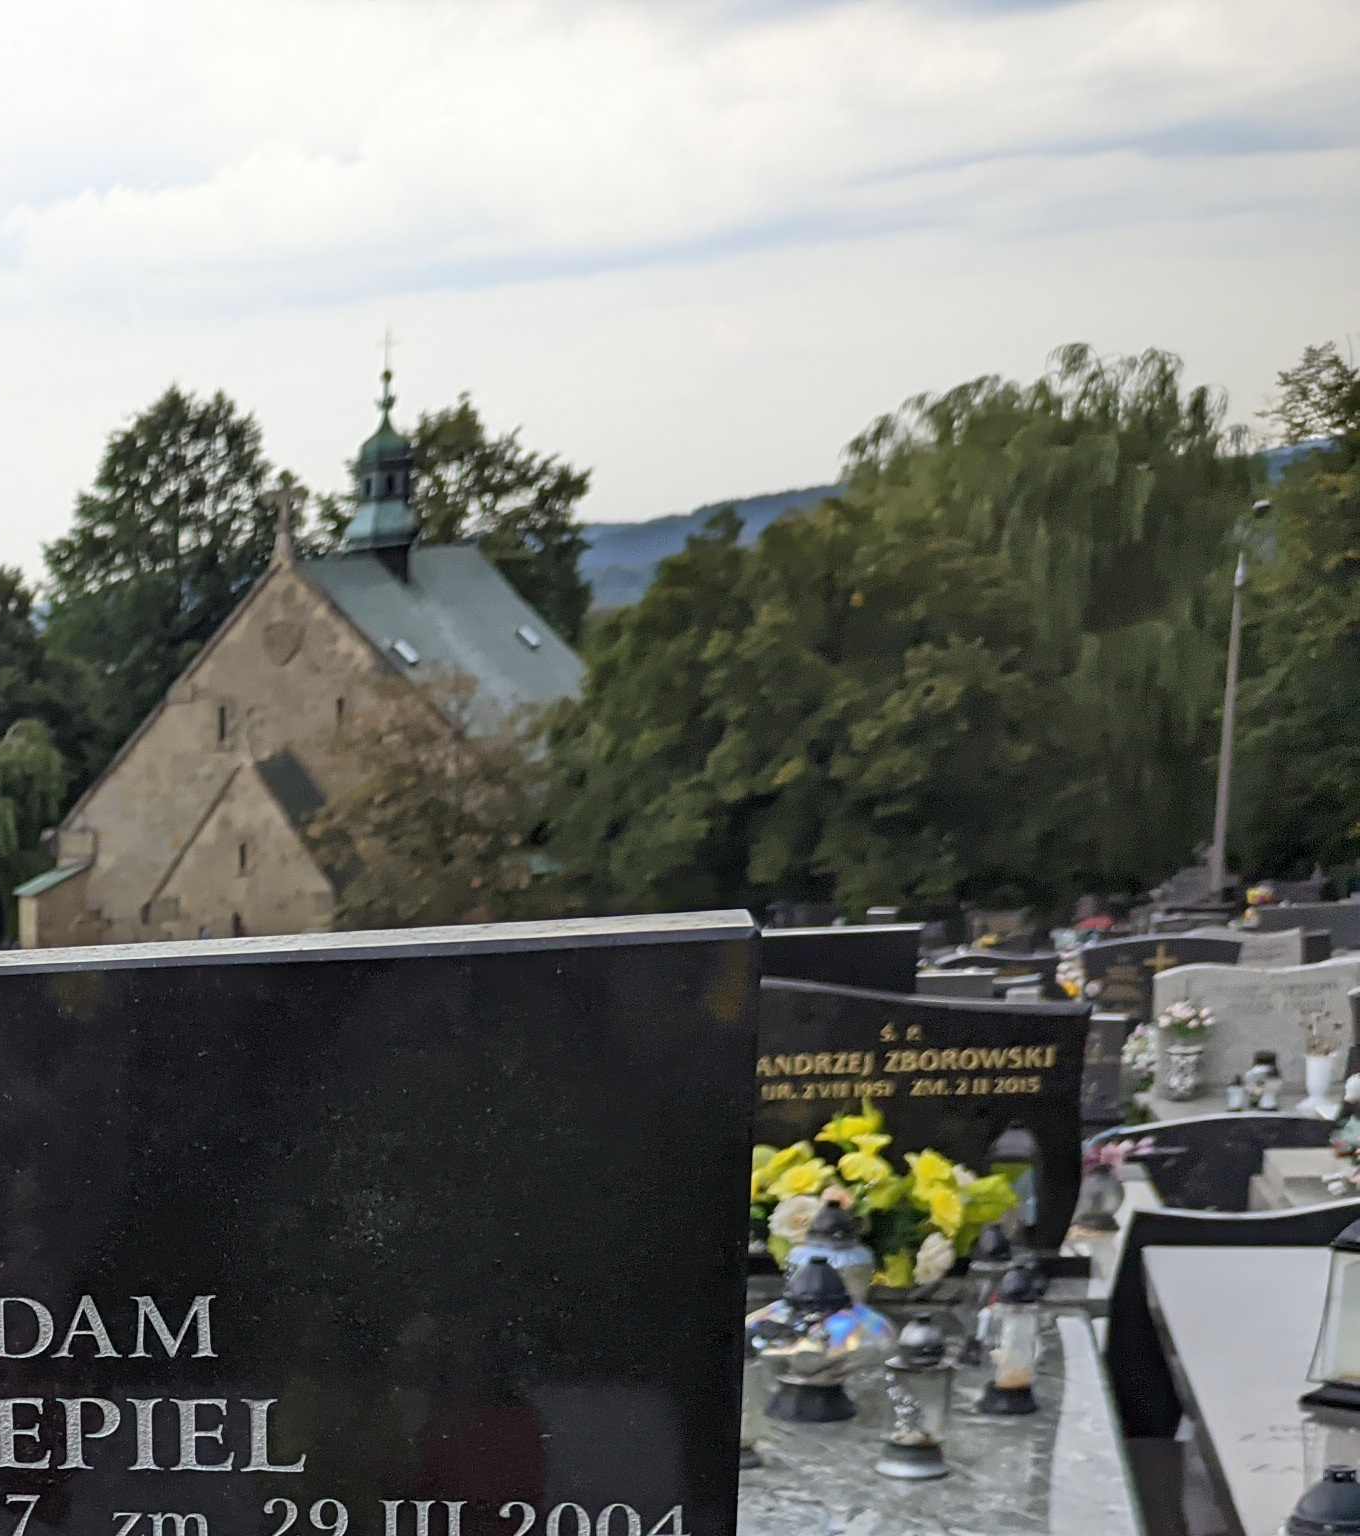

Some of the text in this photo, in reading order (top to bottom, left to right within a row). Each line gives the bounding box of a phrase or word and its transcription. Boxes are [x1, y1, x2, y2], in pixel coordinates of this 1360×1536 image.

[756, 1044, 1059, 1078] ANDRZEJ ZBOROWSKI
[991, 1074, 1043, 1095] 2015
